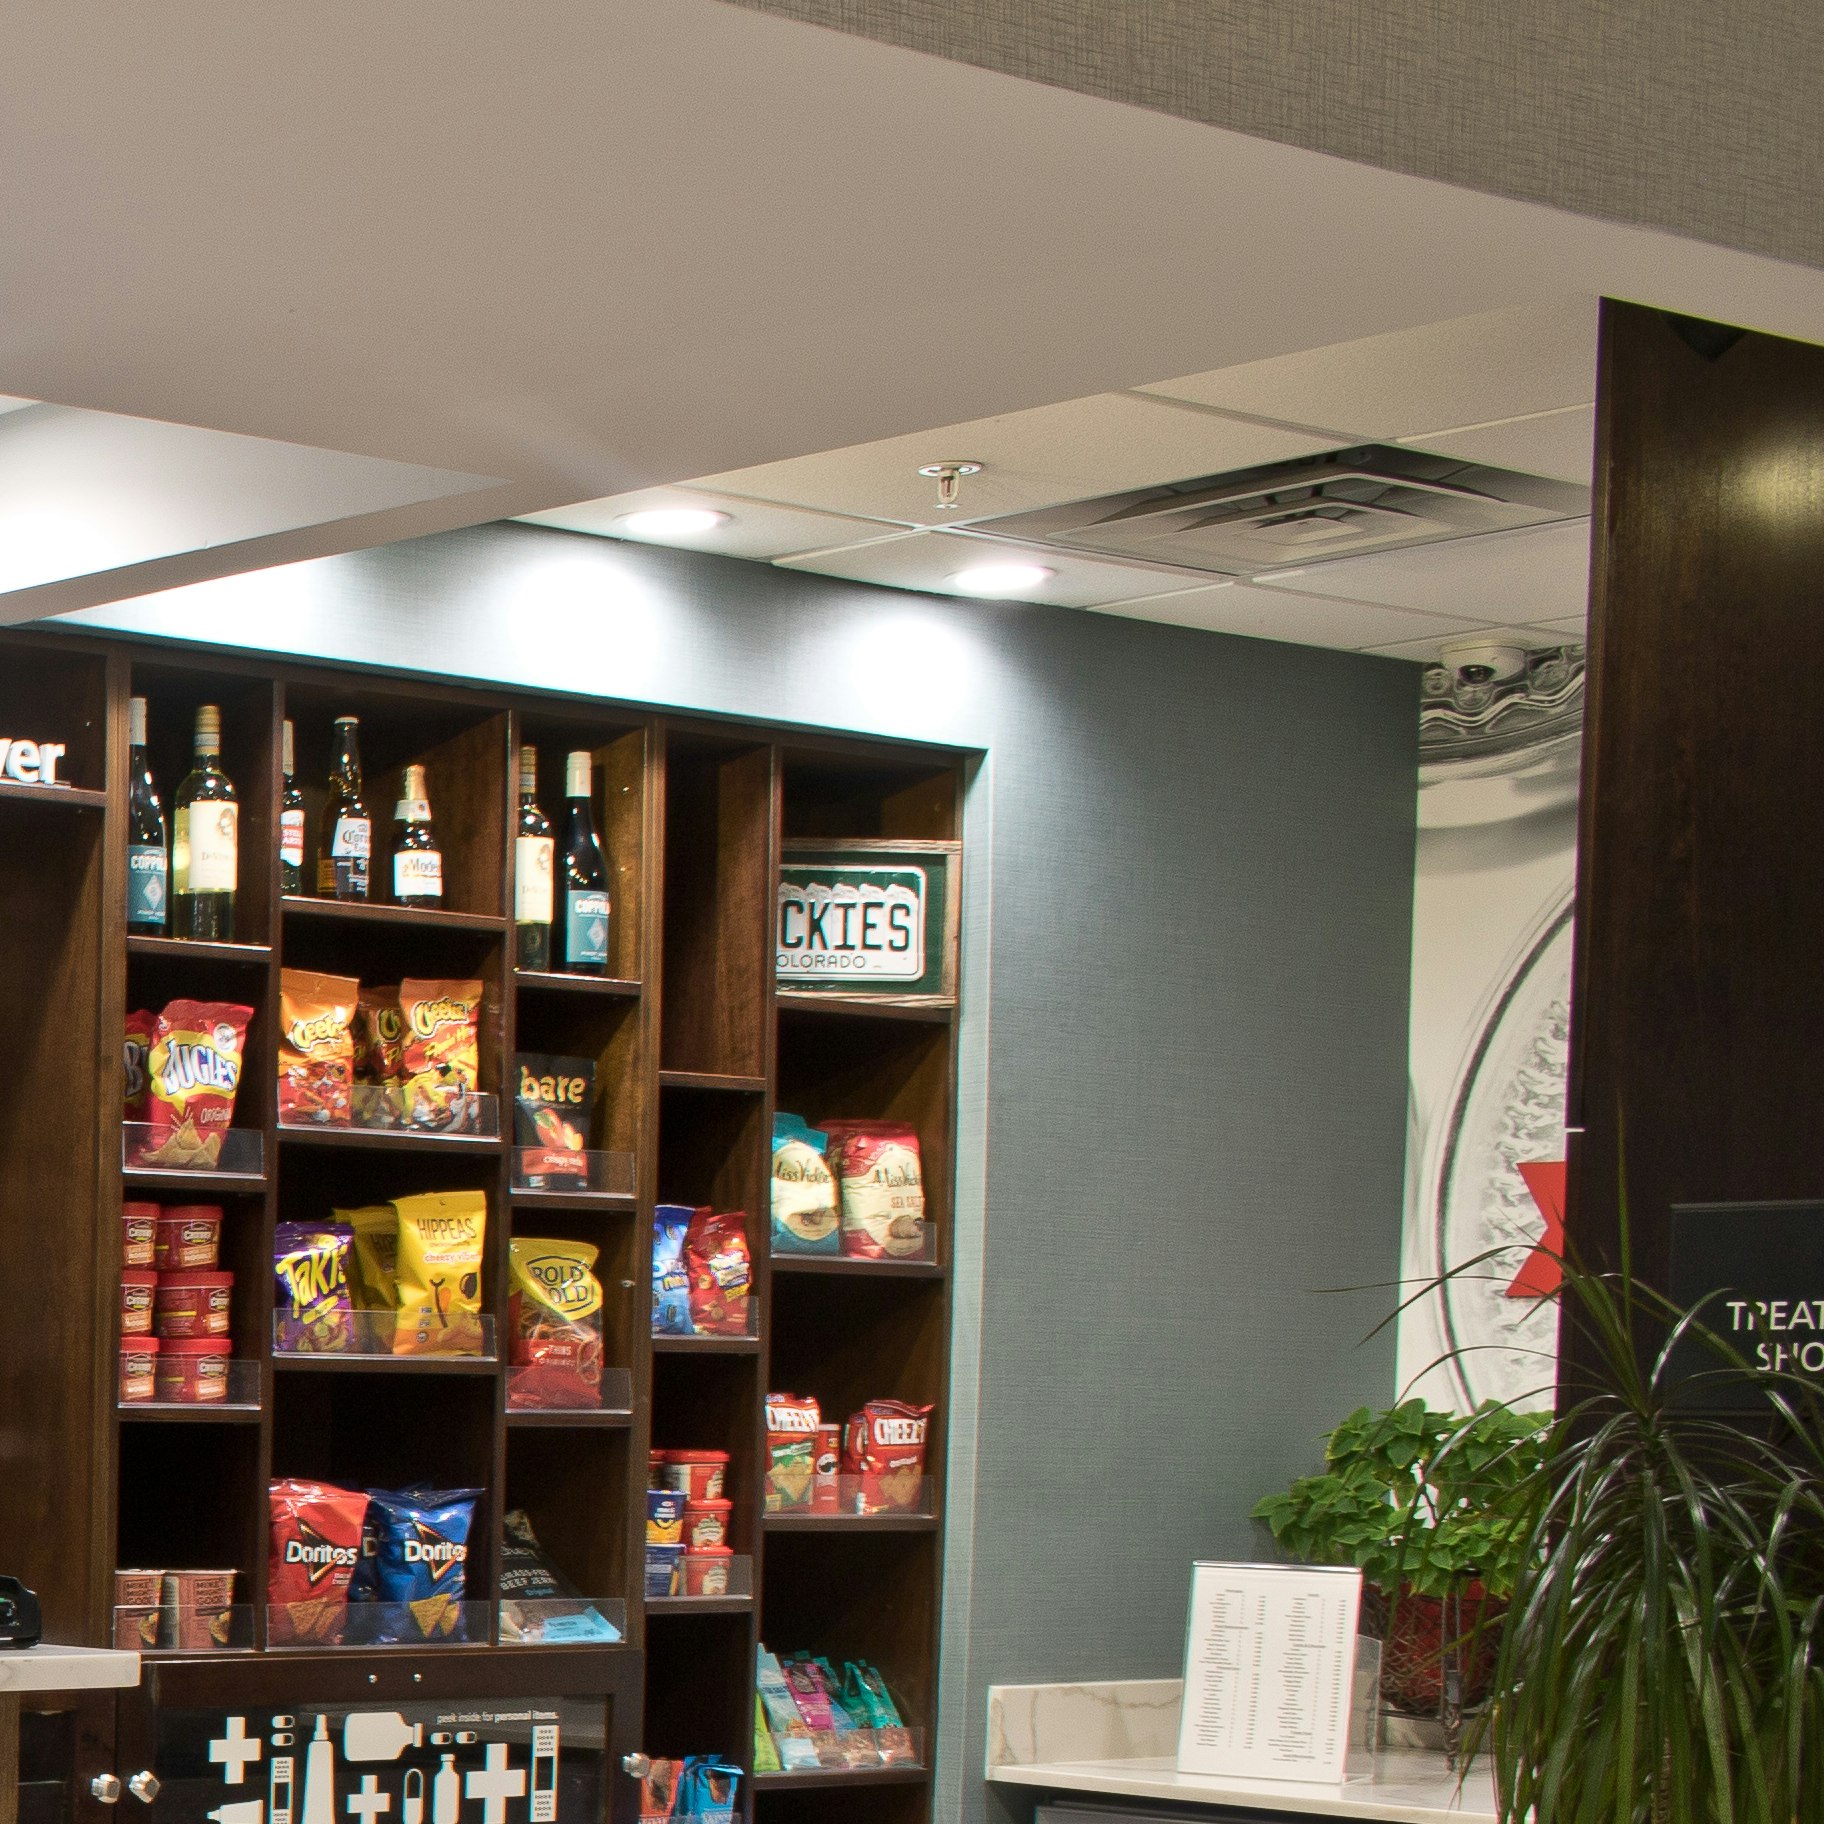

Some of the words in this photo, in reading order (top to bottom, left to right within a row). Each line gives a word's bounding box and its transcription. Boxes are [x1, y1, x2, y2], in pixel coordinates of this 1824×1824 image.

[780, 899, 911, 952] CKIES
[162, 1038, 238, 1096] BUGLES
[520, 1065, 586, 1104] bare
[417, 1217, 478, 1241] HIPPEAS
[548, 1286, 588, 1304] OLD
[286, 1540, 358, 1564] Doritos
[494, 1709, 532, 1723] personal
